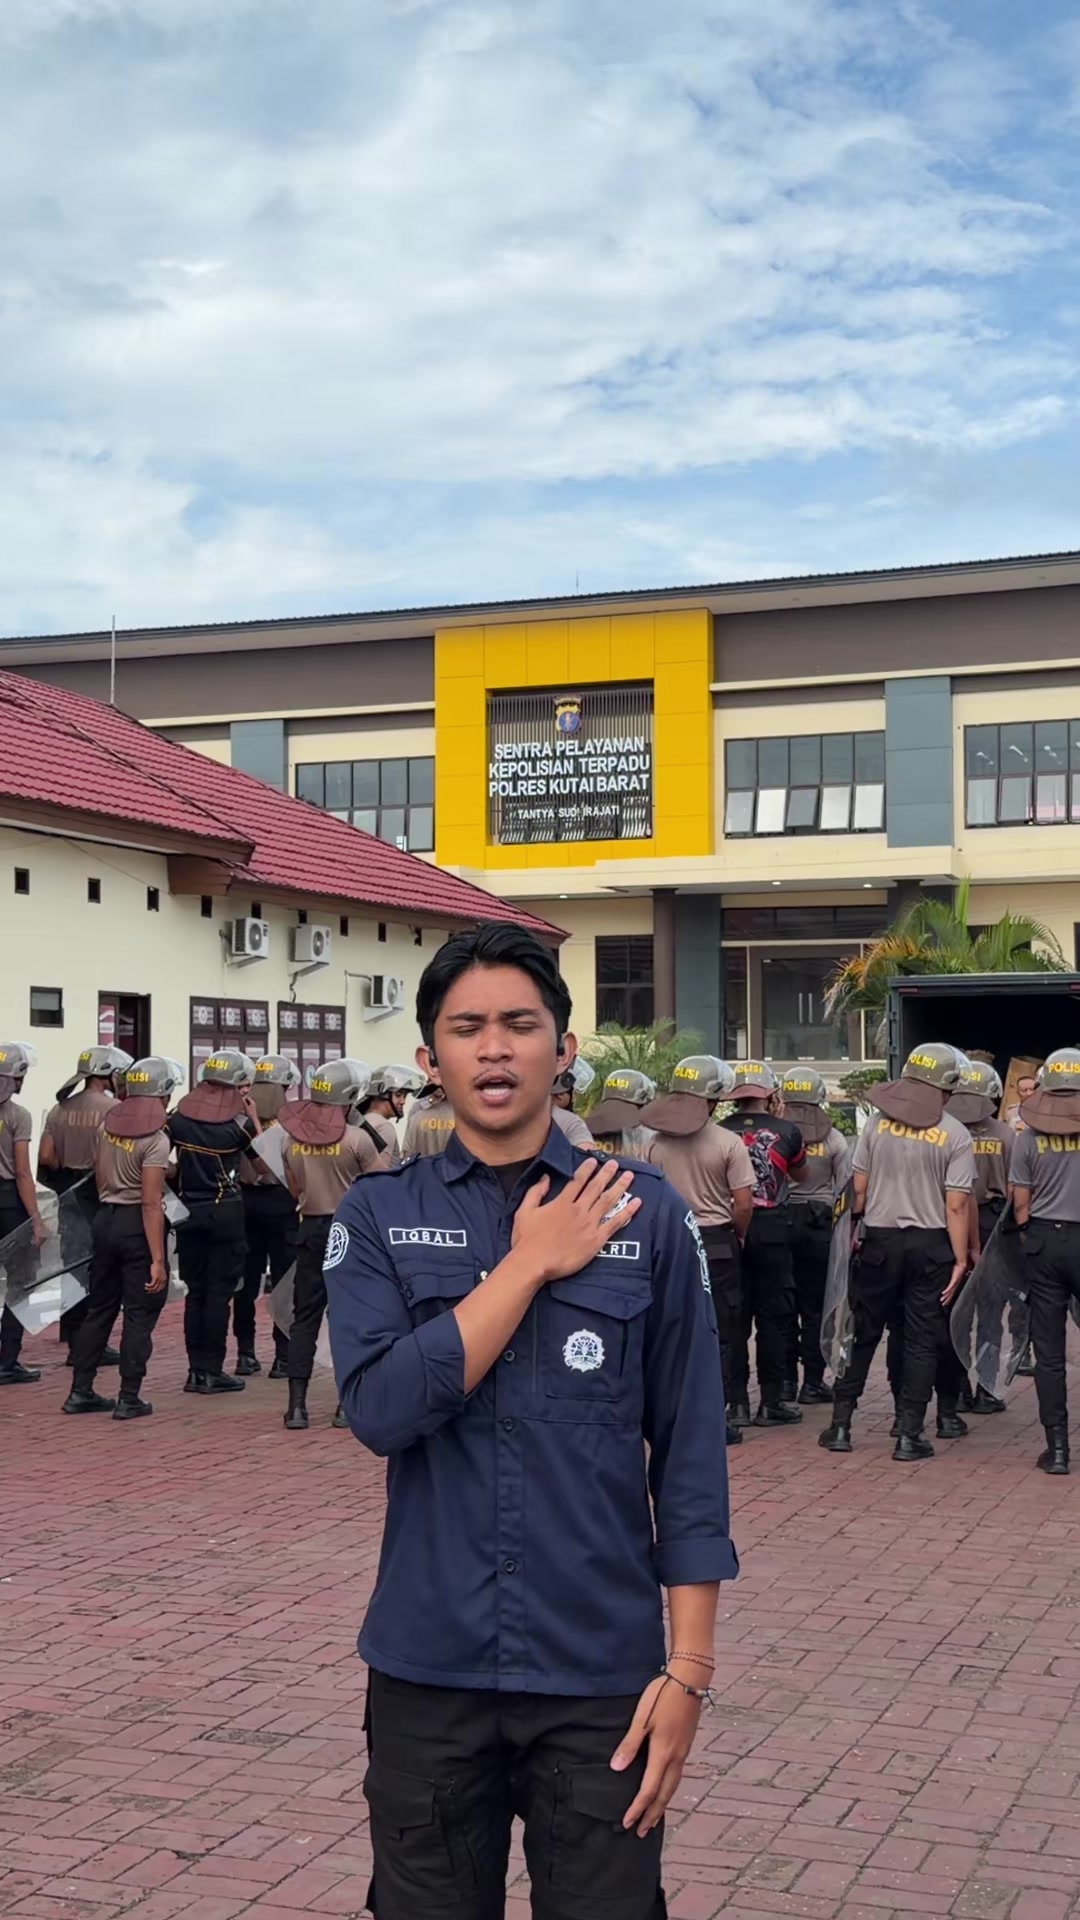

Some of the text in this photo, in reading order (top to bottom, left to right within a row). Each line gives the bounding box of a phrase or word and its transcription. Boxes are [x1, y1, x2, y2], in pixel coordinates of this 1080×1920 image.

[494, 736, 645, 760] SENTRA PELAYANAN
[489, 754, 650, 779] KEPOLISIAN TERPADU
[489, 774, 650, 797] POLRES KUTAI BARAT
[518, 808, 555, 820] TANTYA
[1049, 1062, 1080, 1074] POLIS
[877, 1118, 949, 1148] POLISI
[972, 1140, 1003, 1155] LISI
[402, 1231, 454, 1244] IQBAL
[600, 1244, 627, 1256] LRI
